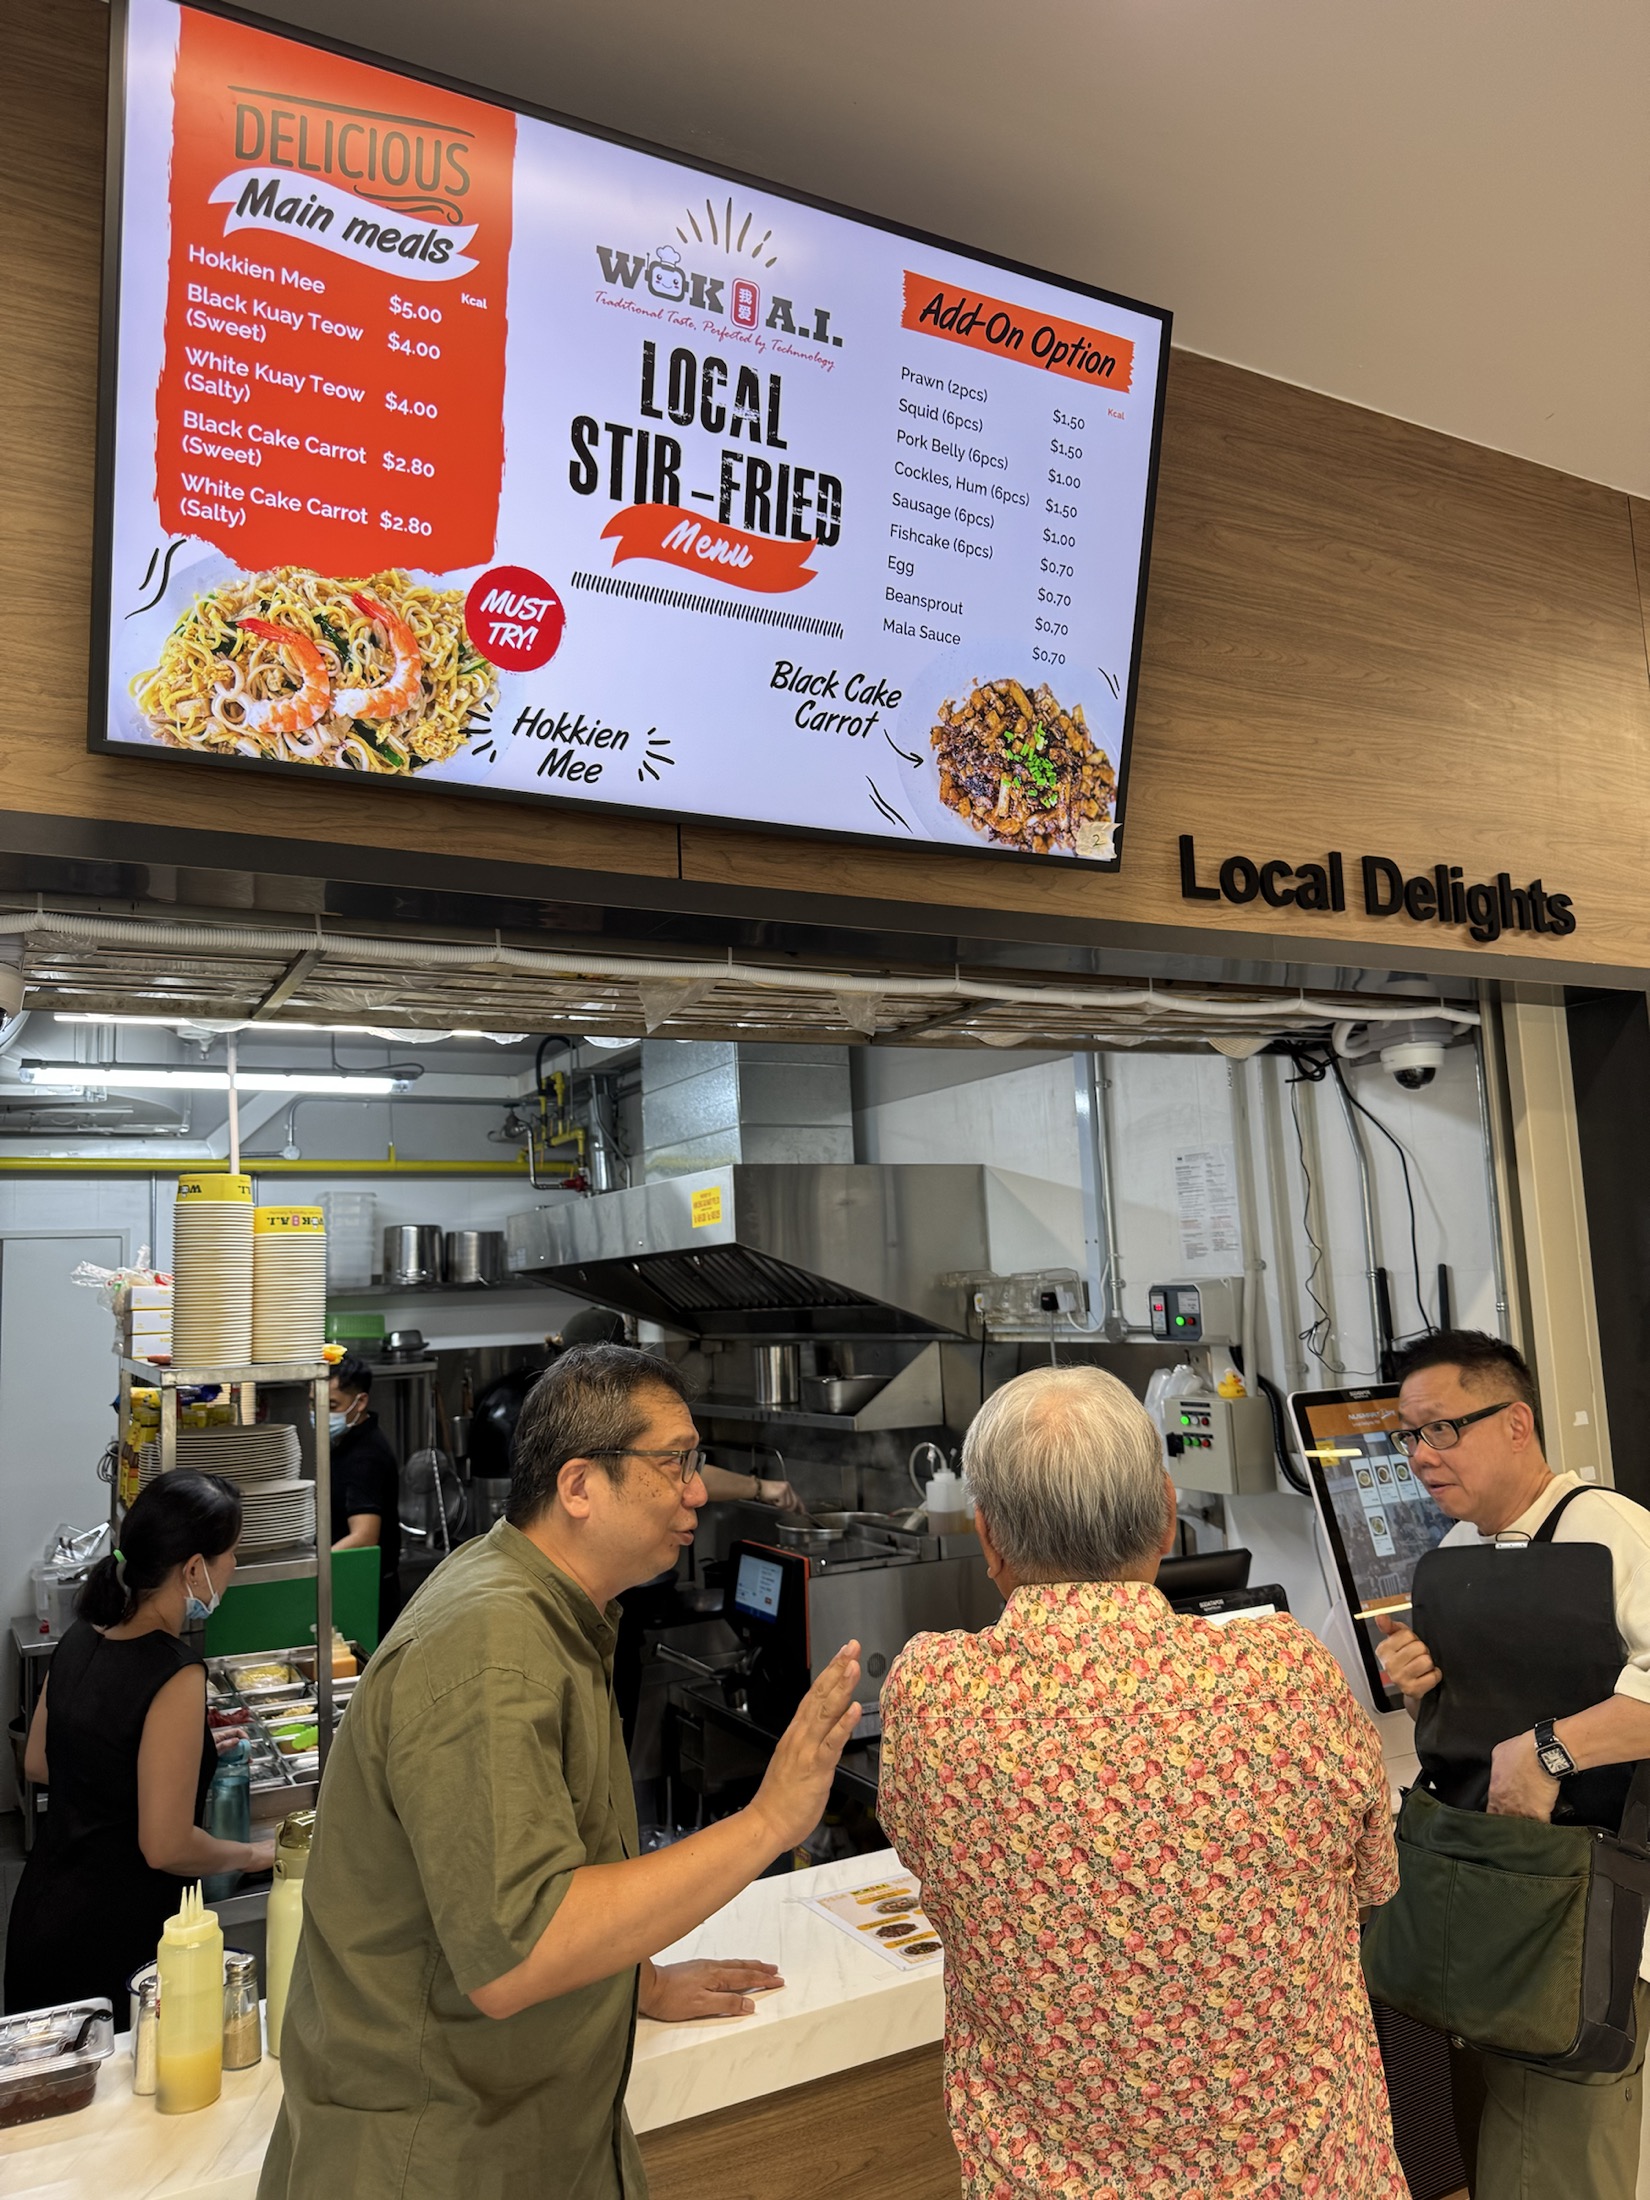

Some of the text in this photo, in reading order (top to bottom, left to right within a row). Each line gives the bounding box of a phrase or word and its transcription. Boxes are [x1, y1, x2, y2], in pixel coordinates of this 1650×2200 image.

[235, 104, 471, 197] DELICIOUS
[235, 178, 455, 265] Main meals
[189, 244, 326, 295] Hokkien Mee
[187, 283, 364, 342] Black Kuay Teow
[388, 294, 443, 324] $5.00
[461, 292, 487, 310] Kcal
[186, 308, 267, 344] (Sweet)
[595, 291, 663, 321] Traditional
[667, 309, 697, 331] Taste,
[703, 320, 753, 344] Perfected
[754, 334, 768, 355] by
[766, 295, 843, 347] A.I.
[919, 293, 1116, 378] Add-On Option
[387, 331, 441, 361] $4.00
[184, 372, 251, 404] (Salty)
[185, 346, 365, 404] White Kuay Teow
[901, 366, 988, 402] Prawn (2pcs)
[384, 391, 438, 420] $4.00
[640, 340, 788, 450] LOCAL
[899, 399, 983, 433] Squid (6pcs)
[1053, 409, 1085, 431] $1.50
[1107, 407, 1125, 421] Kcal
[182, 434, 263, 469] (Sweet)
[183, 410, 367, 465] Black Cake Carrot
[897, 429, 1008, 470] Pork Belly (6pcs)
[1050, 439, 1083, 460] $1.50
[381, 450, 435, 479] $2.80
[1048, 469, 1081, 490] $1.00
[181, 473, 368, 526] White Cake Carrot
[894, 461, 1030, 507] Cockles, Hum (6pcs)
[179, 499, 247, 529] (Salty)
[379, 510, 433, 538] $2.80
[892, 492, 995, 529] Sausage (6pcs)
[1045, 498, 1078, 519] $1.50
[661, 519, 754, 569] Menu
[890, 523, 993, 560] Fishcake (6pcs)
[1042, 528, 1076, 549] $1.00
[888, 555, 915, 577] Egg
[1040, 557, 1074, 579] $0.70
[480, 588, 556, 623] MUST
[885, 586, 964, 616] Beansprout
[1037, 587, 1072, 608] $0.70
[488, 620, 539, 652] TRY!
[883, 618, 961, 646] Mala Sauce
[1035, 616, 1069, 637] $0.70
[1032, 646, 1066, 667] $0.70
[770, 660, 903, 710] Black Cake
[512, 706, 629, 752] Hokkien
[794, 700, 879, 739] Carrot
[537, 747, 603, 784] Mee
[1092, 834, 1106, 848] 2
[1179, 834, 1577, 942] Local Delights
